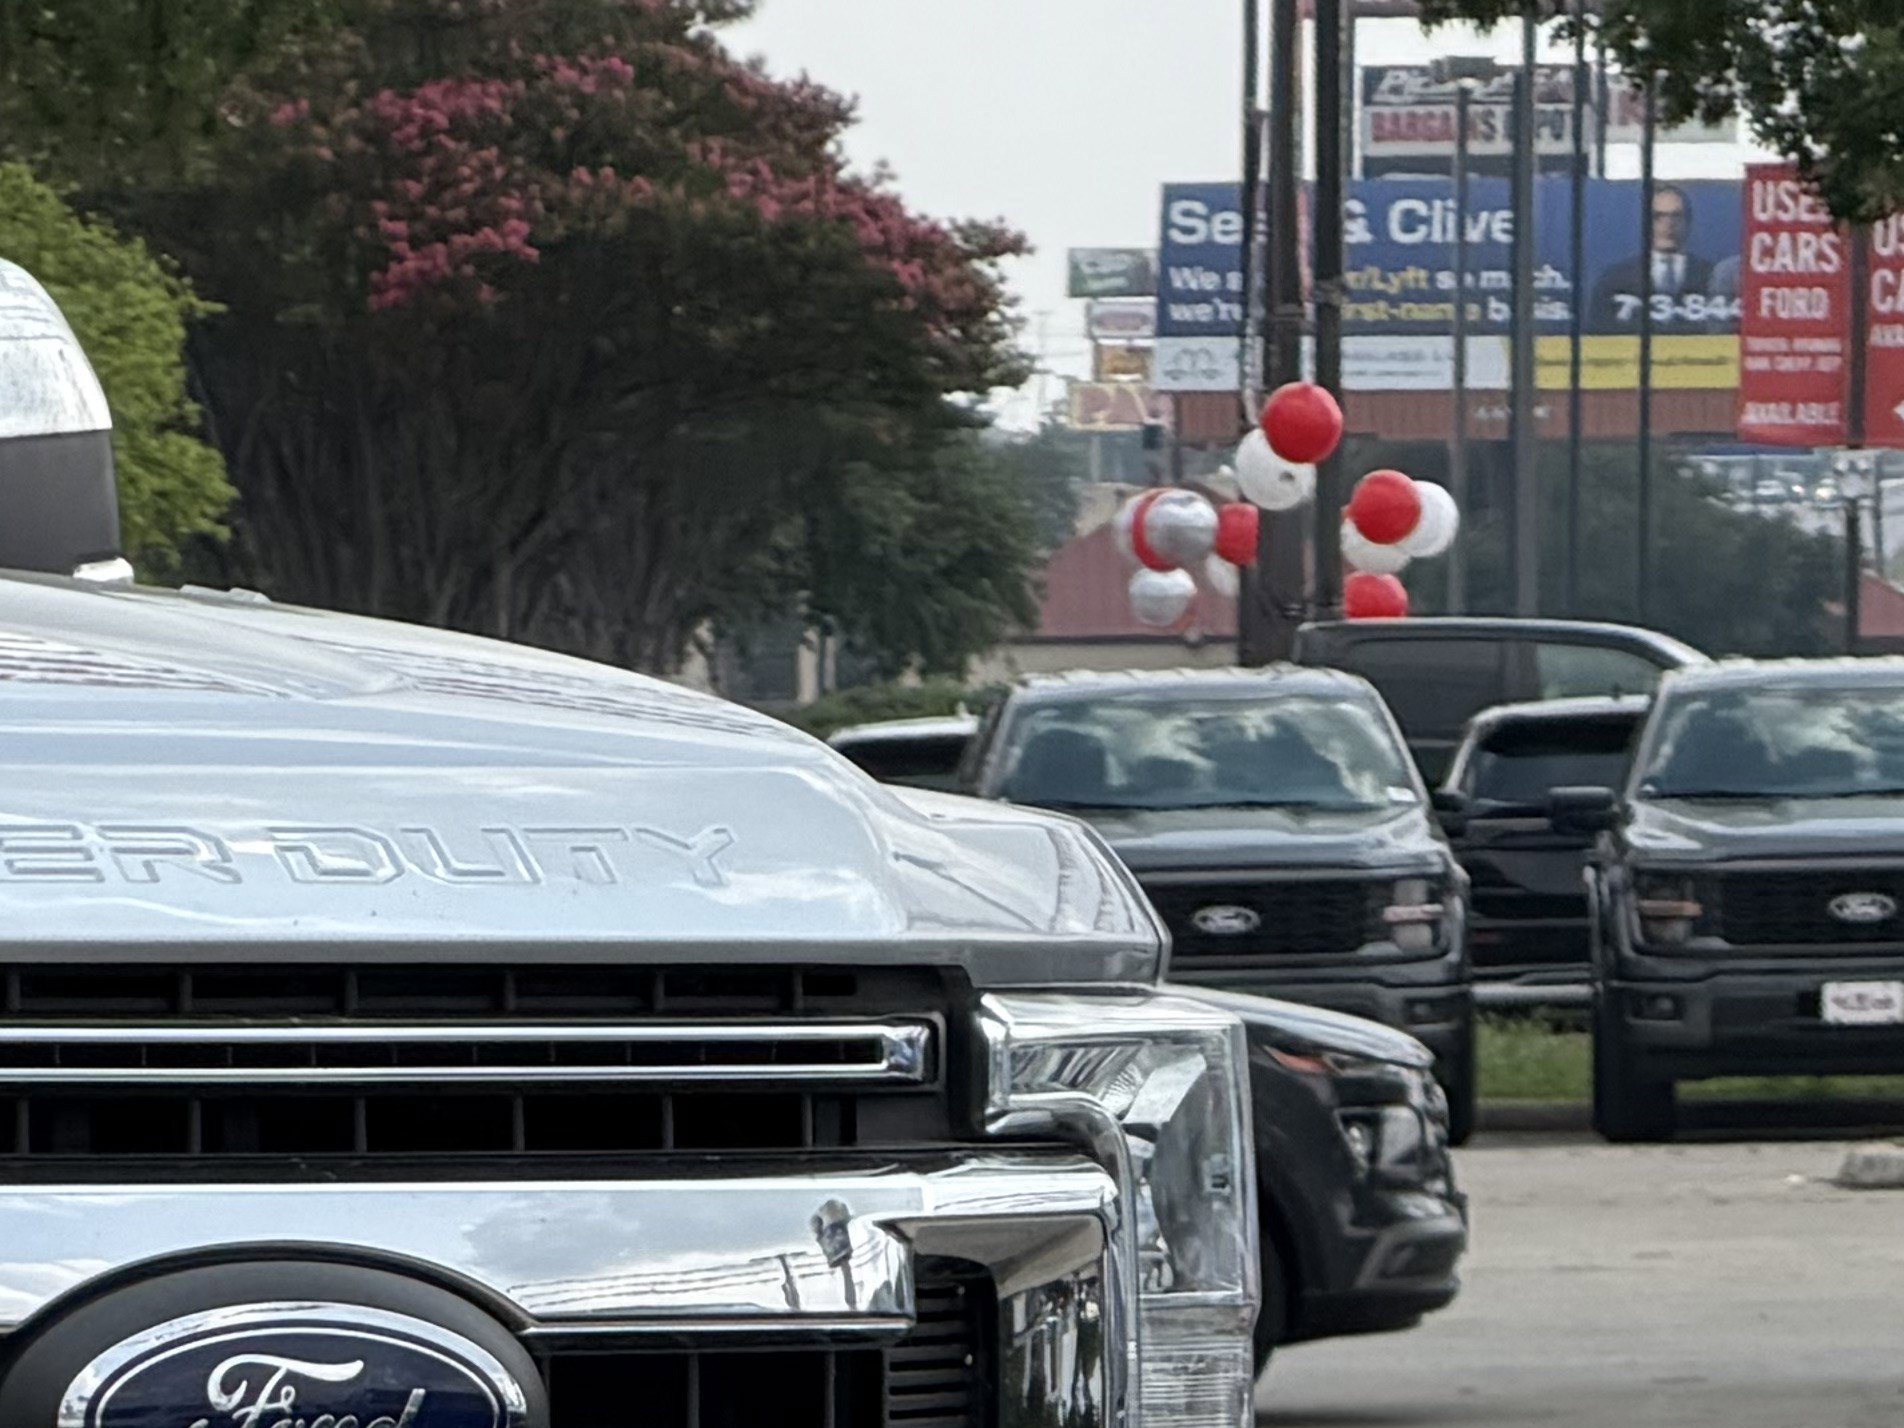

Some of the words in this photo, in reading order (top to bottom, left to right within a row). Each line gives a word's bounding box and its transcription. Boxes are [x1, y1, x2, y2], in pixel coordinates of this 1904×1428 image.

[1750, 231, 1842, 274] CARS
[1758, 286, 1830, 320] FORD
[266, 824, 738, 887] DUTY
